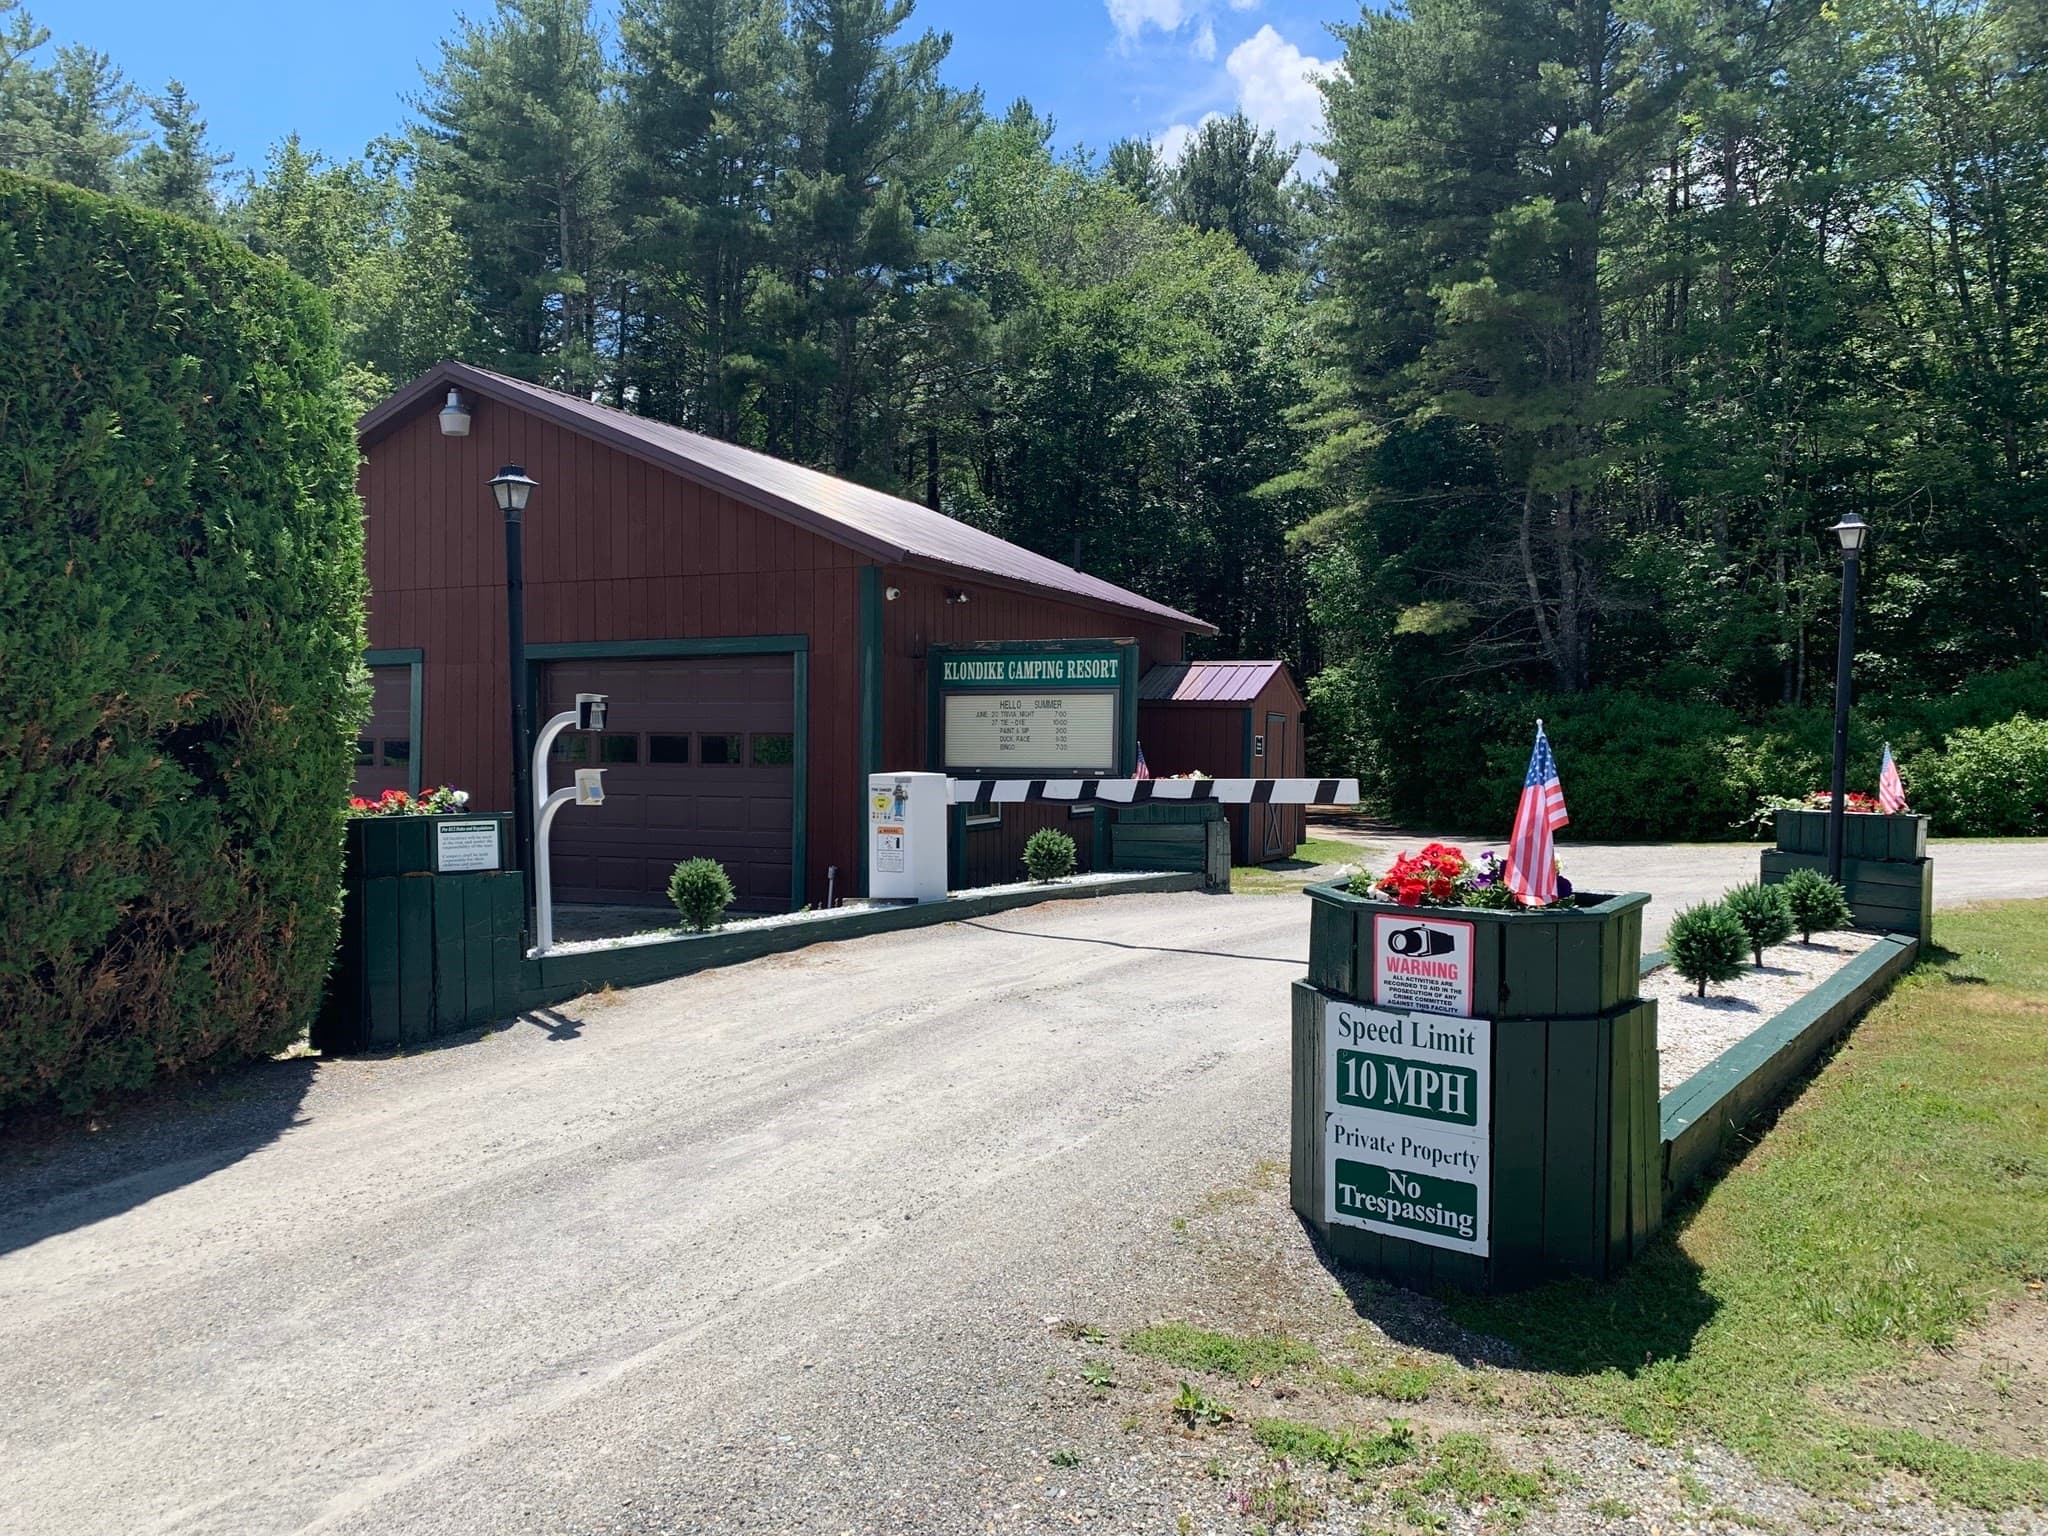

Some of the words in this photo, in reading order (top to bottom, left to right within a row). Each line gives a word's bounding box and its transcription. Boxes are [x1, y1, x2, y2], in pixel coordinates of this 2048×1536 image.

[944, 661, 1004, 680] KLONDIKE
[1008, 660, 1064, 680] CAMPING
[1068, 659, 1118, 679] RESORT
[1000, 700, 1022, 709] HELLO
[1034, 700, 1062, 709] SUMMER
[1386, 956, 1458, 980] WARNING
[1384, 980, 1417, 989] RECORDED
[1406, 976, 1439, 985] ACTIVITIES
[1389, 987, 1432, 998] PROSECUTION
[1415, 996, 1452, 1006] COMMITTED
[1387, 999, 1414, 1007] AGAINST
[1431, 1004, 1458, 1013] FACILITY
[1338, 1011, 1402, 1046] Speed
[1412, 1021, 1476, 1056] Limit
[1344, 1057, 1377, 1100] 10
[1384, 1062, 1468, 1116] MPH
[1334, 1124, 1395, 1154] Private
[1400, 1136, 1480, 1174] Property
[1385, 1172, 1421, 1199] No
[1338, 1182, 1474, 1236] Trespassing
